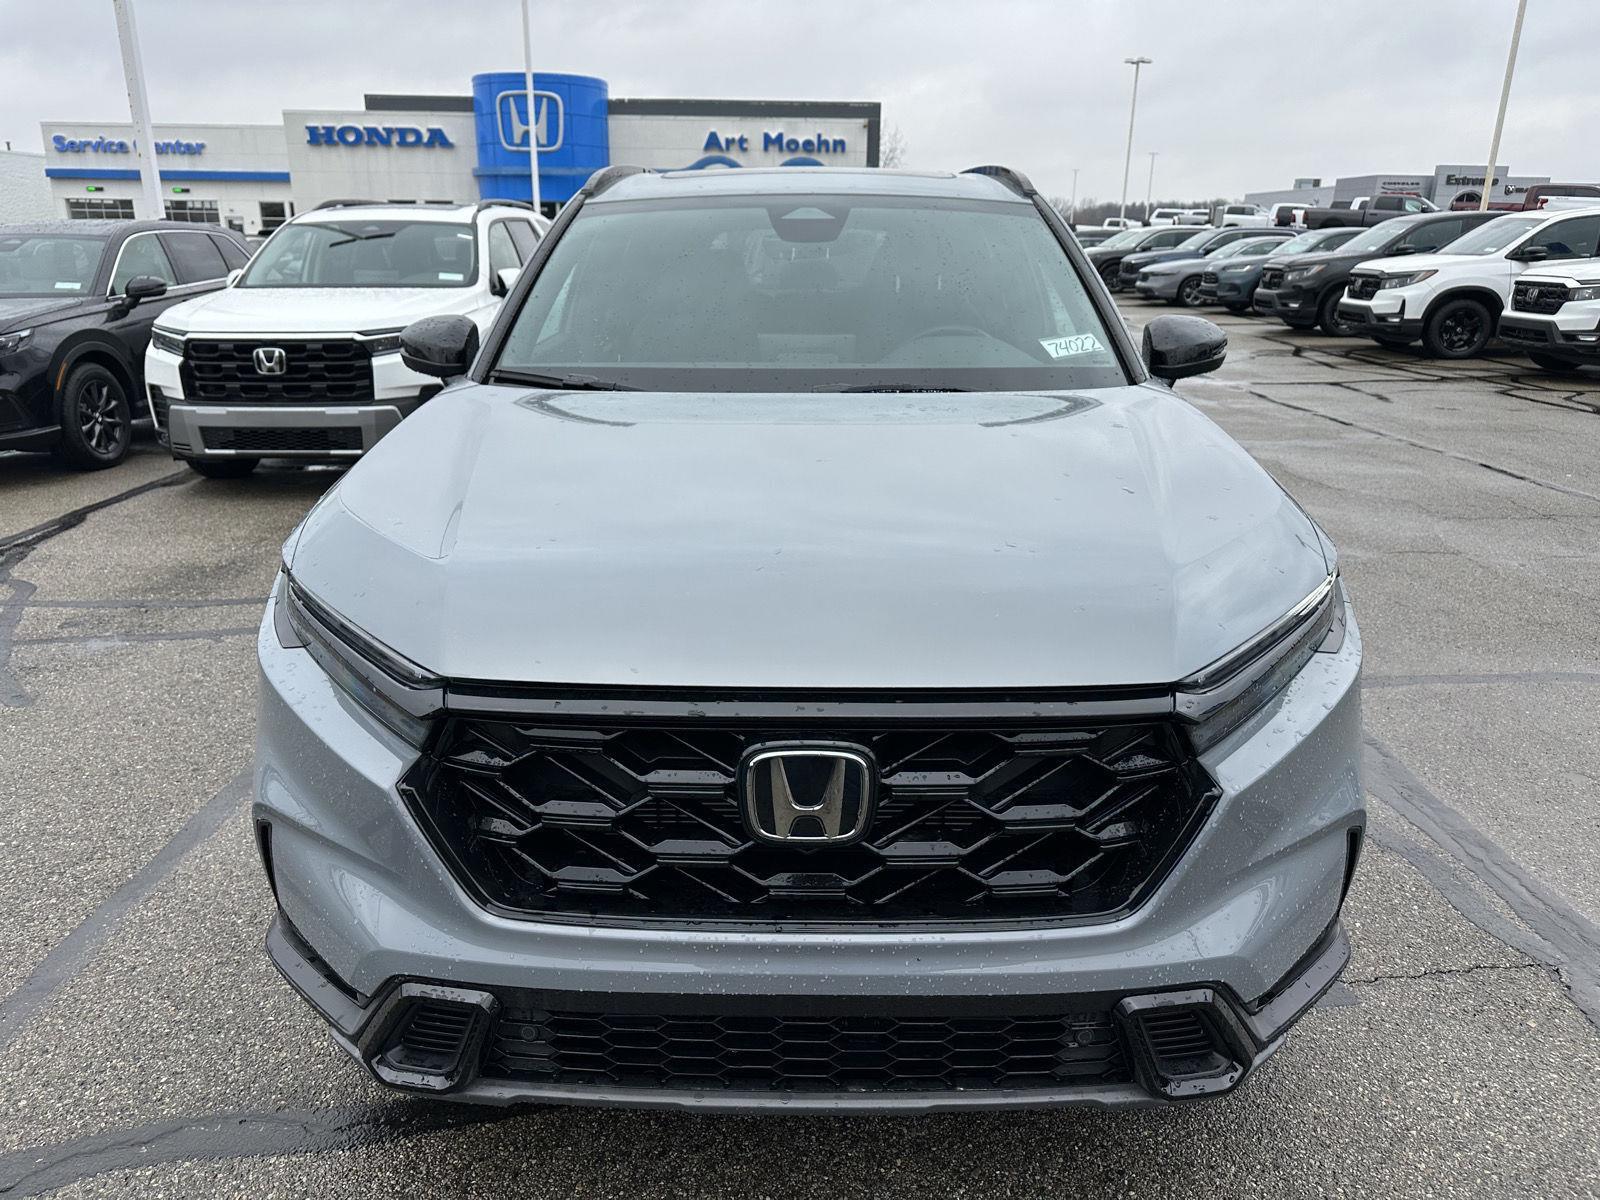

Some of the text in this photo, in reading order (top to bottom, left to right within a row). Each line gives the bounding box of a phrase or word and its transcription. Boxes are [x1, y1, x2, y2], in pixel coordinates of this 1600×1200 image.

[53, 135, 206, 155] Service enter
[305, 126, 454, 148] HONDA
[703, 131, 846, 153] Art Moehn
[1047, 336, 1102, 355] 74022
